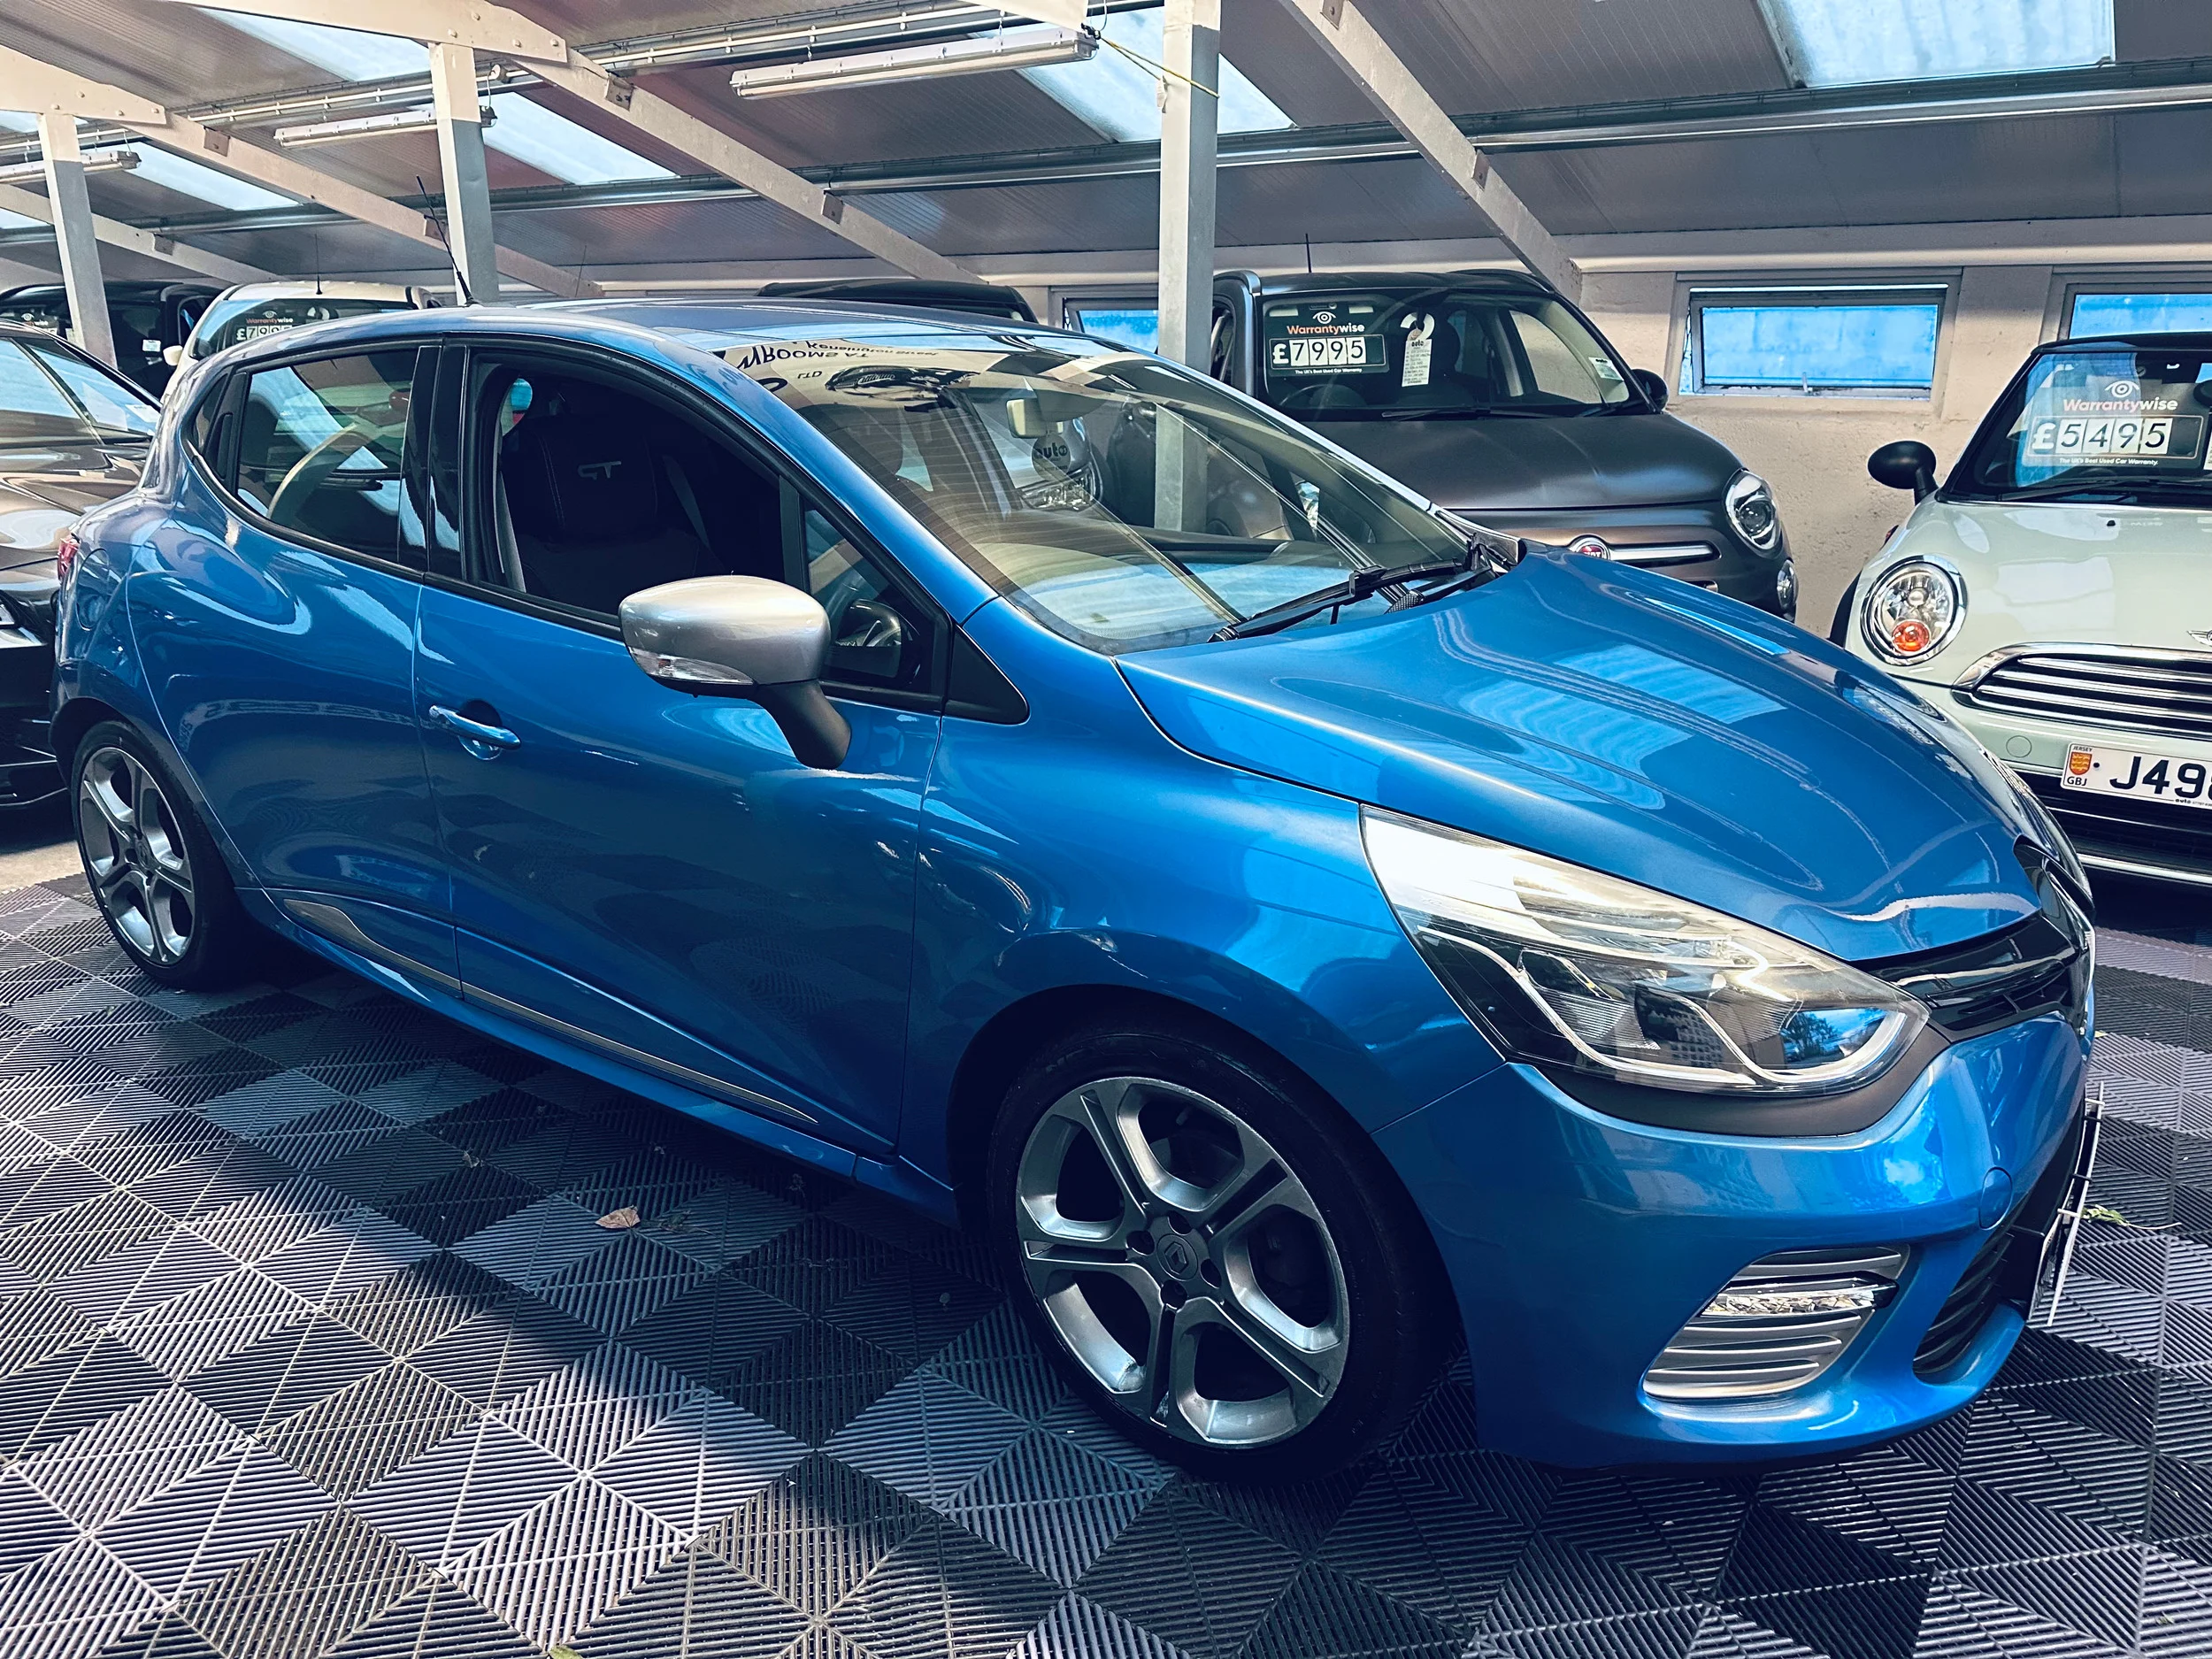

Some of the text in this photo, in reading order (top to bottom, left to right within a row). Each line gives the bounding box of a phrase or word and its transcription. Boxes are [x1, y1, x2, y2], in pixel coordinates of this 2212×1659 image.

[236, 326, 290, 341] £79
[1286, 322, 1365, 335] Warrantywise
[1272, 340, 1363, 365] £7995
[2062, 396, 2177, 413] Warrantywise
[2032, 422, 2167, 449] £5495
[577, 460, 622, 480] GT
[2067, 776, 2088, 787] GBJ
[2109, 756, 2212, 802] J49
